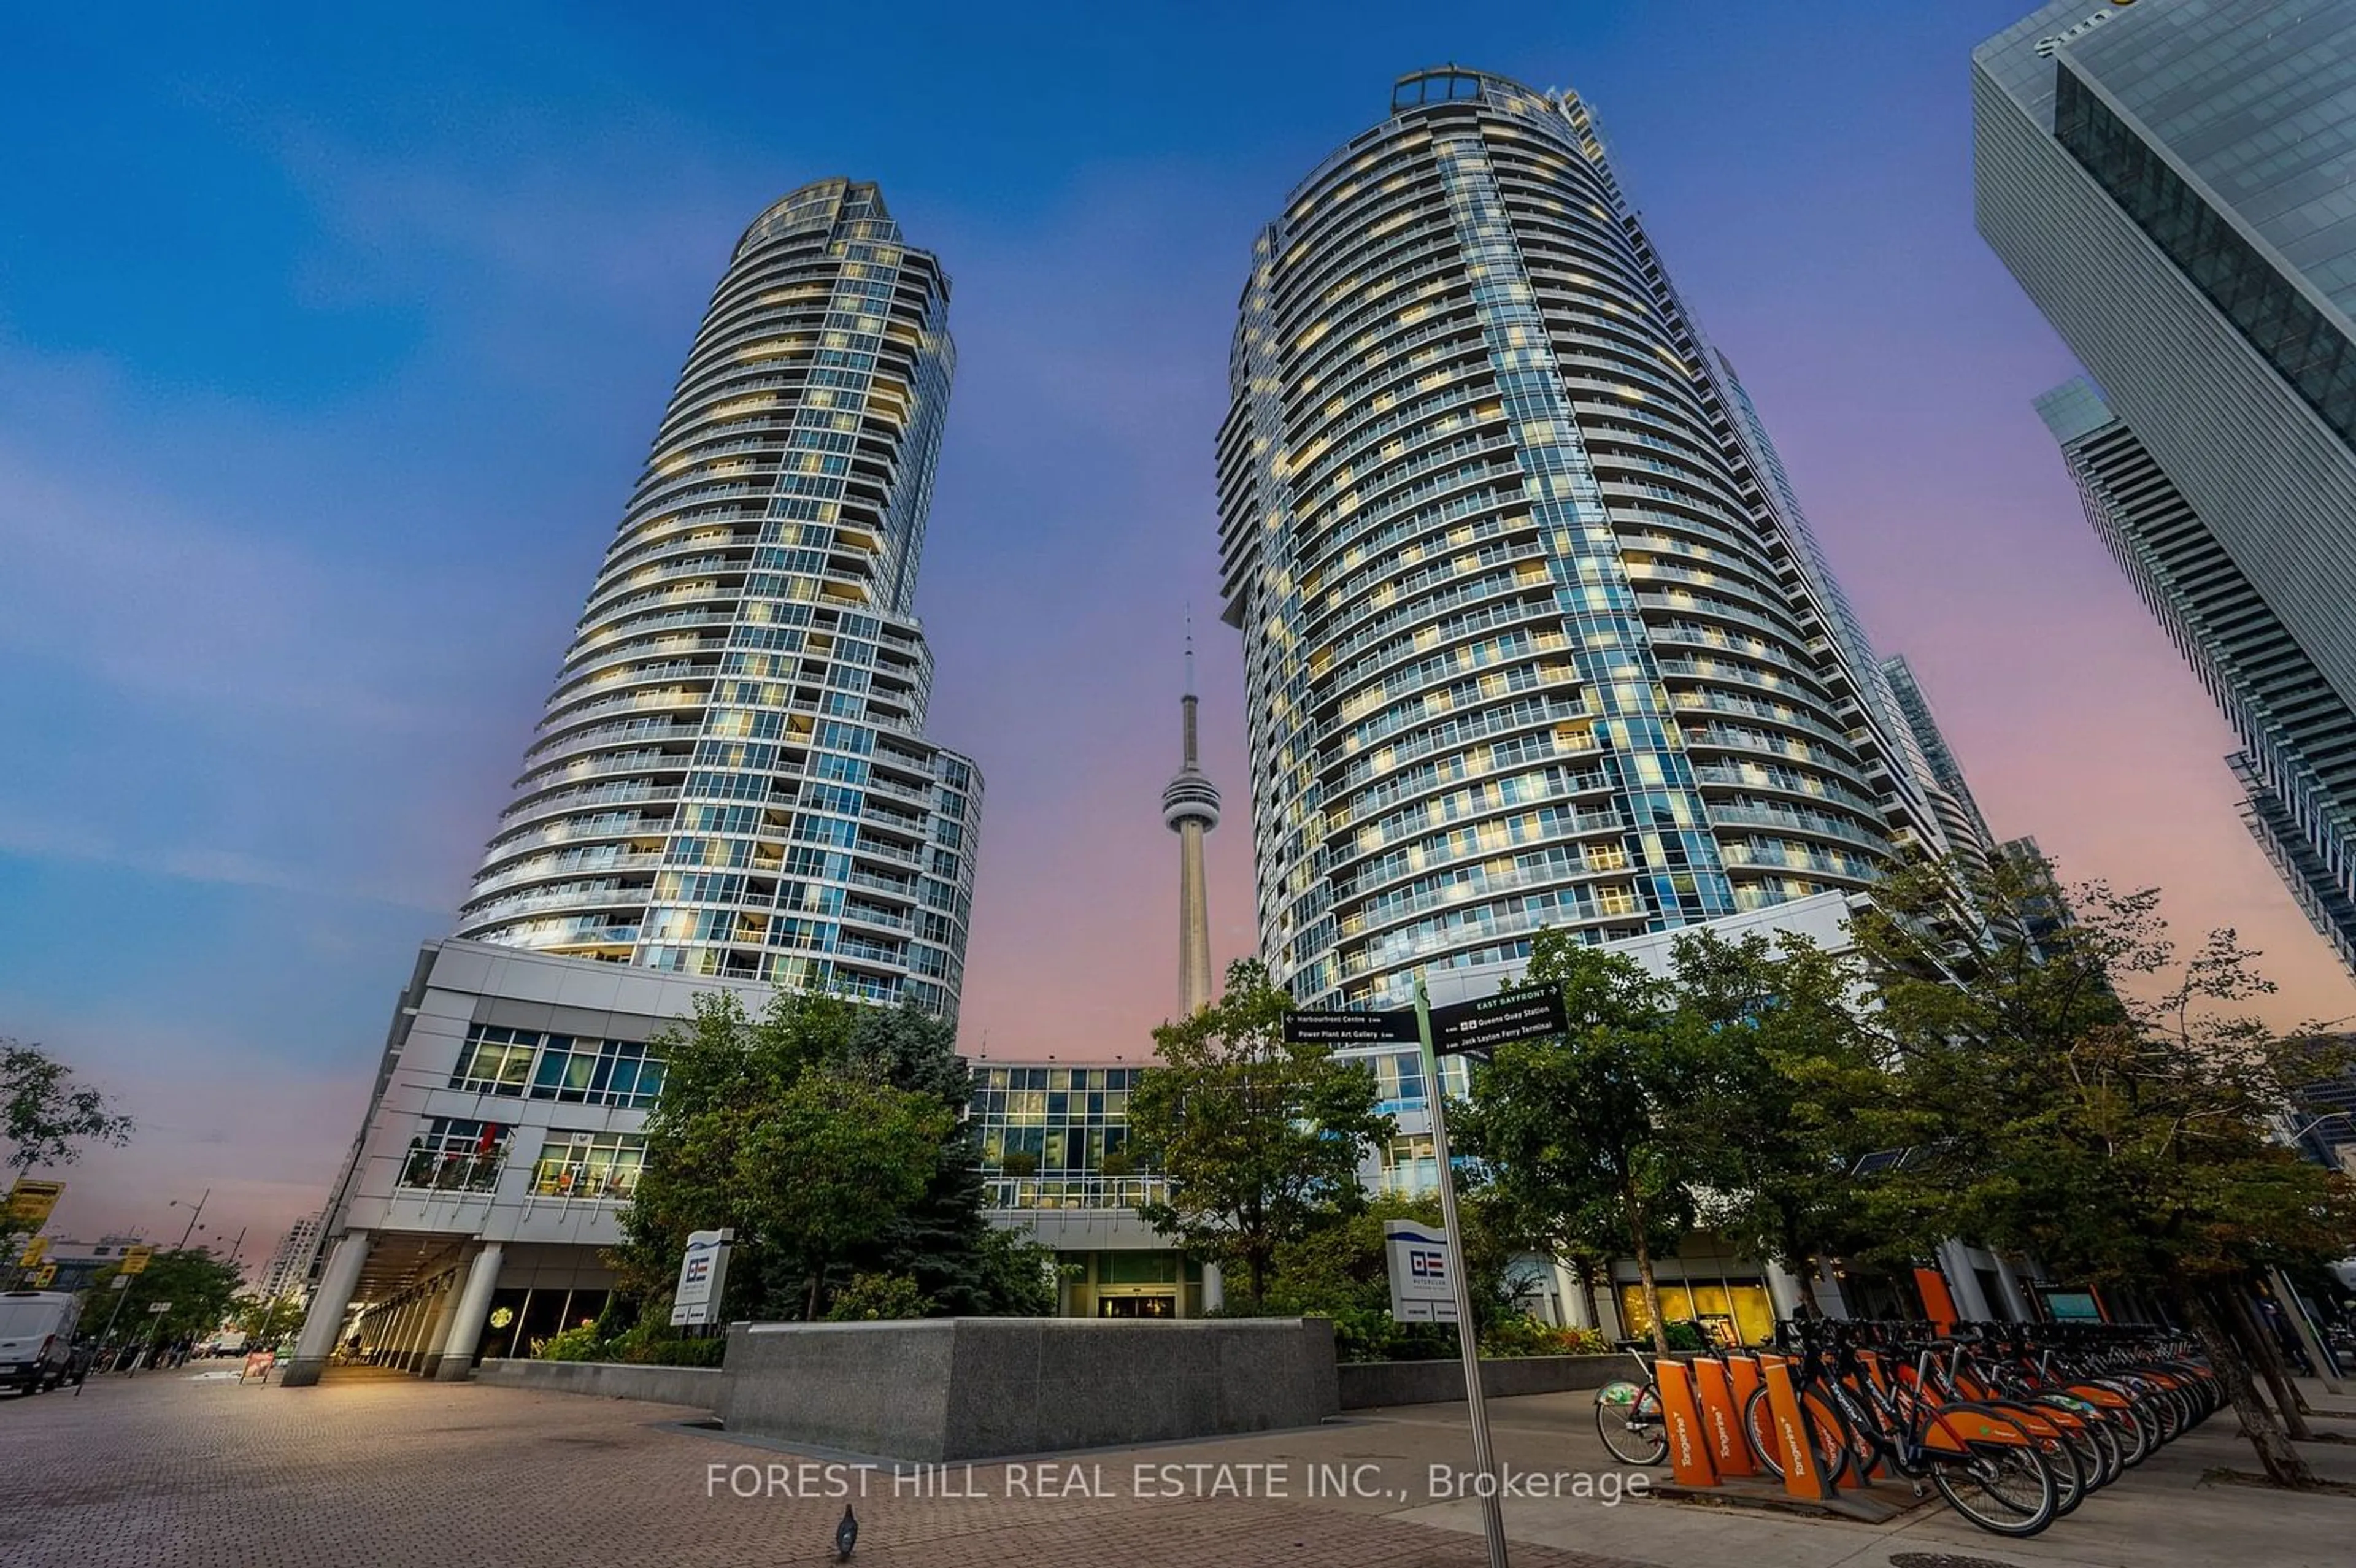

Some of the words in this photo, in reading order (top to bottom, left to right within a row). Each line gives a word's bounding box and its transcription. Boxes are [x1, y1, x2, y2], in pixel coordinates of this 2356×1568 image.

[1477, 999, 1498, 1010] EAST
[1499, 990, 1546, 1006] BAYFRONT
[1523, 1006, 1550, 1018] Station
[1353, 1031, 1377, 1039] Gallery
[1521, 1021, 1553, 1034] Terminal
[1677, 1418, 1693, 1467] Tangerine
[1715, 1411, 1731, 1459] Tangerine
[1785, 1423, 1806, 1477] Tangerine
